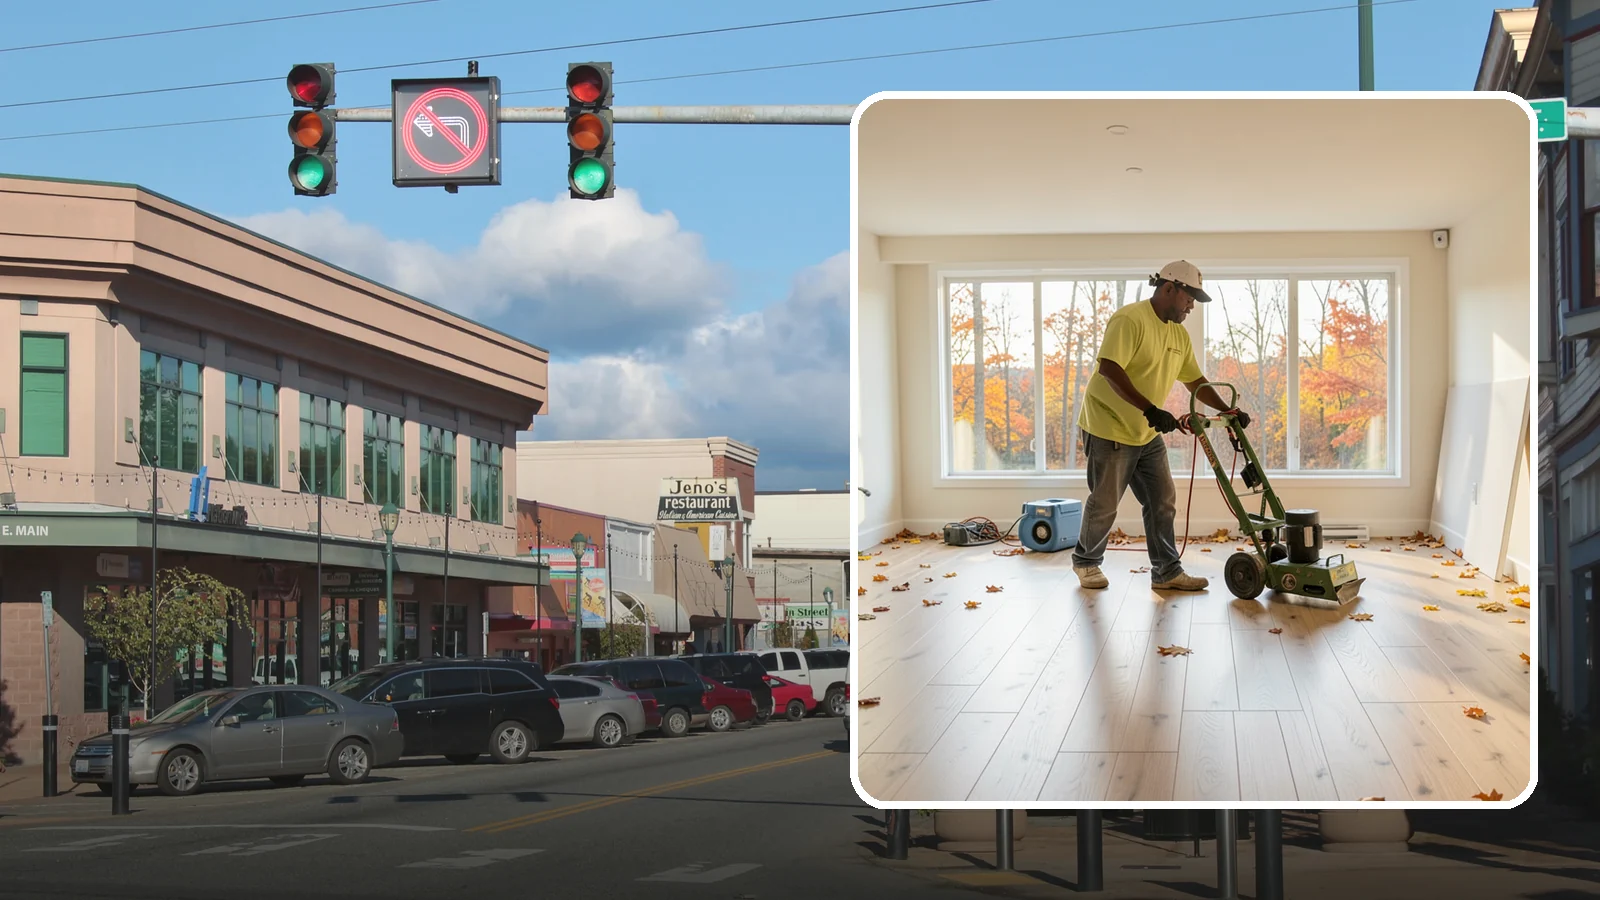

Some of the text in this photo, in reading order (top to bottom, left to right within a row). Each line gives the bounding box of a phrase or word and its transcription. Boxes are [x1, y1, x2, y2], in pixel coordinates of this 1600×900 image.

[669, 480, 727, 494] Jeno's
[665, 496, 731, 509] restaurant
[658, 510, 682, 520] Italian
[686, 510, 714, 519] American
[715, 509, 737, 519] Cuisine
[2, 525, 49, 536] E. MAIN
[797, 607, 828, 616] Street
